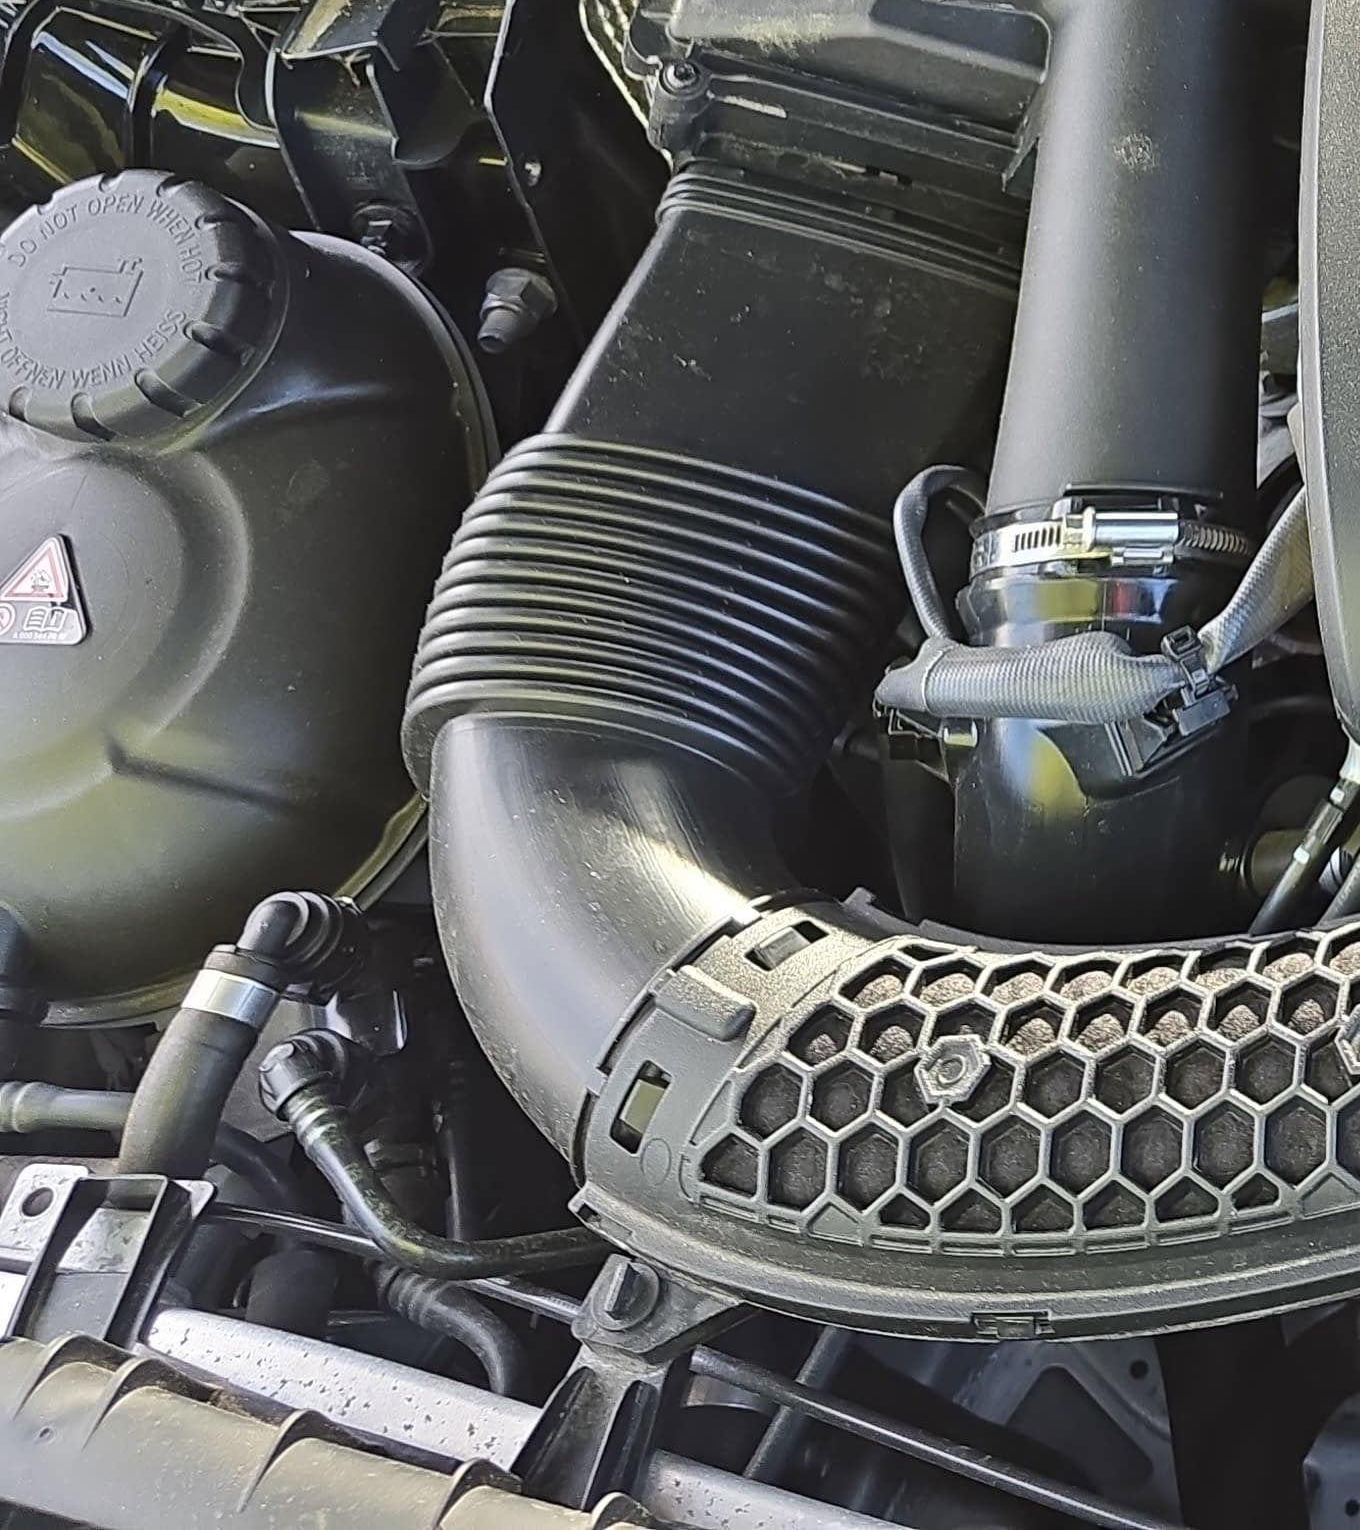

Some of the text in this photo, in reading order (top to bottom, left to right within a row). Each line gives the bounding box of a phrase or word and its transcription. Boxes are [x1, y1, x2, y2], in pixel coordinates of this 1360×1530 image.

[8, 193, 204, 284] DO NOT OPEN WHEN HOT
[72, 355, 133, 390] WENN
[134, 308, 188, 363] HEISS
